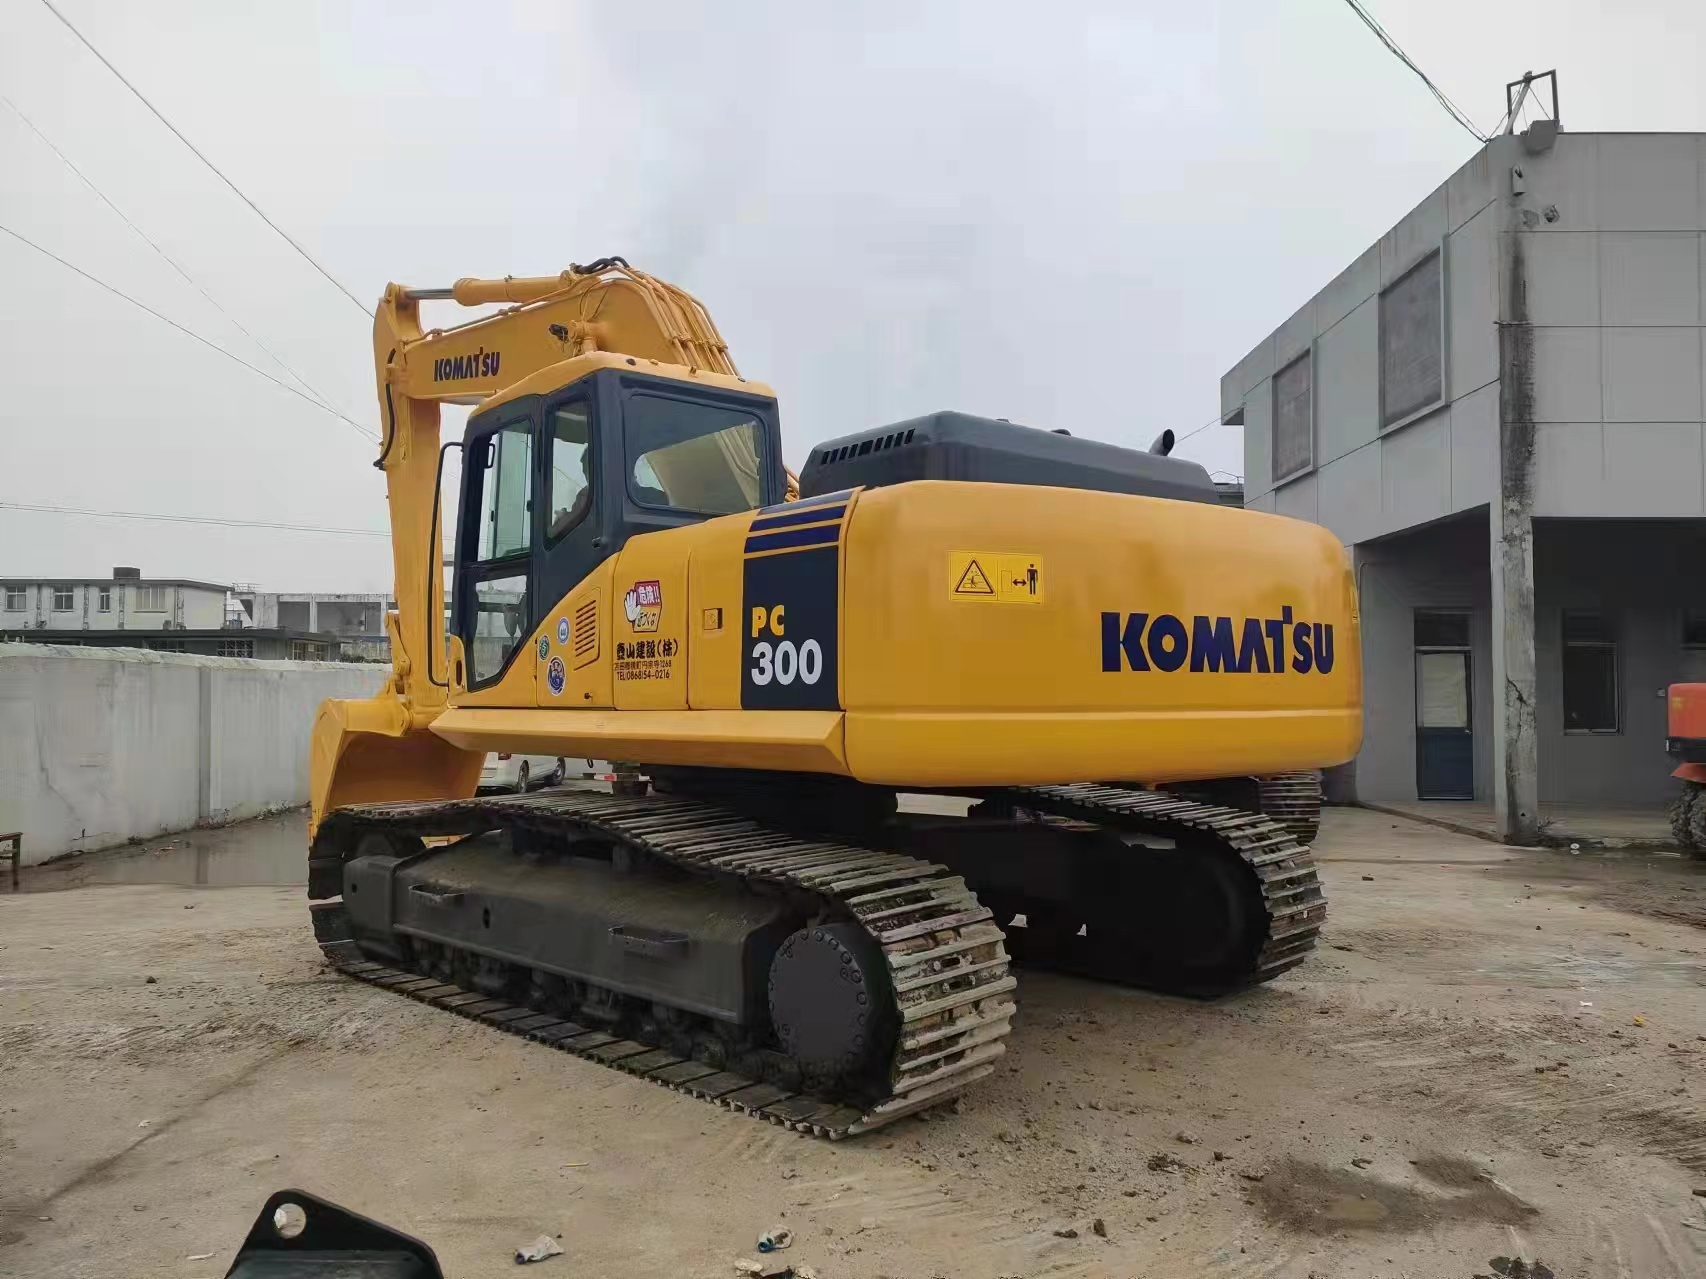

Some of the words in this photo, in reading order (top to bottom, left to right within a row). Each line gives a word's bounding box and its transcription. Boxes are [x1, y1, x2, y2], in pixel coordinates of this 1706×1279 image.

[433, 346, 501, 382] KOMATSU
[751, 604, 785, 638] PC
[1101, 605, 1334, 674] KOMATSU
[751, 638, 823, 686] 300
